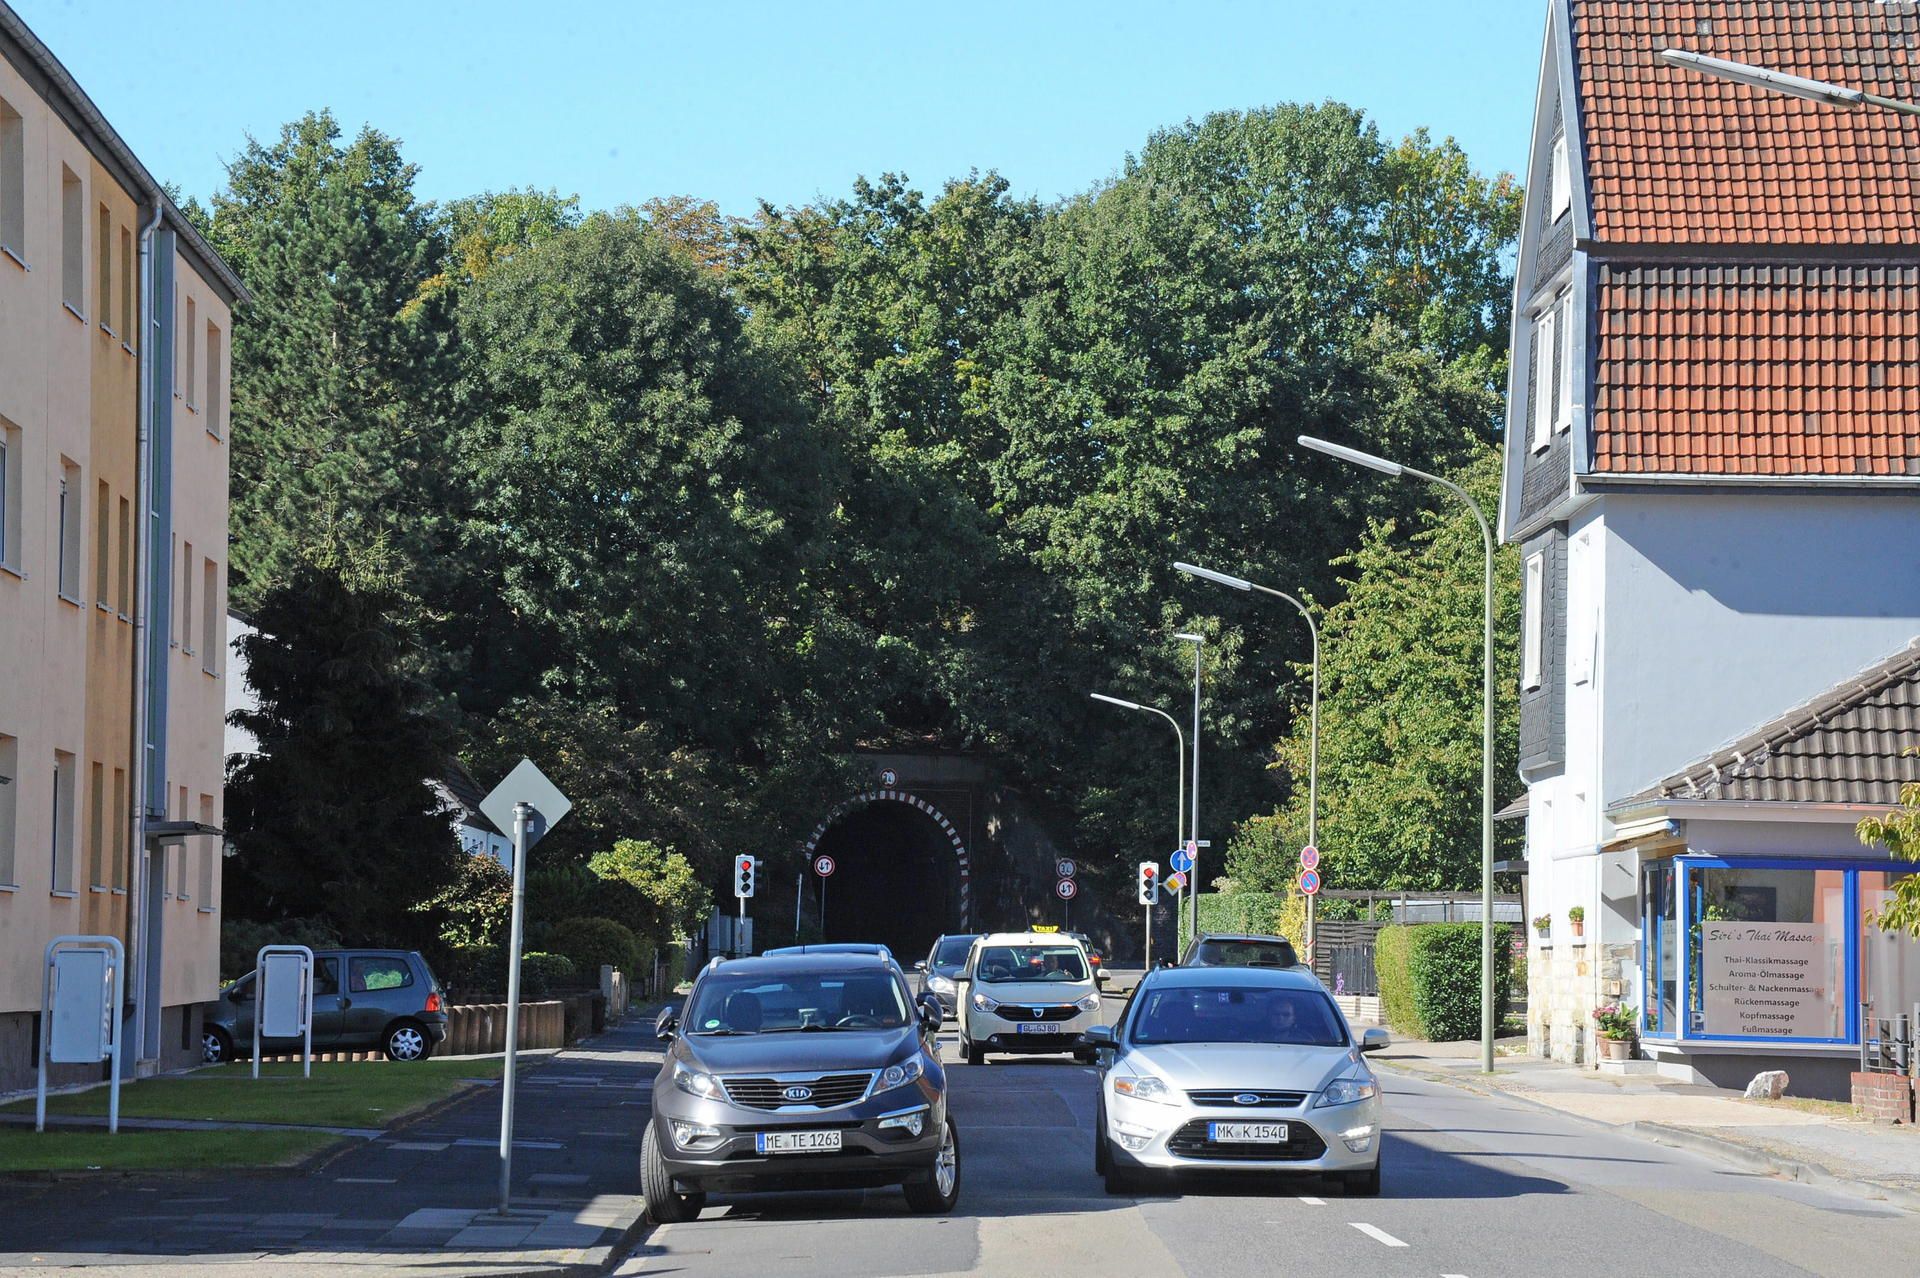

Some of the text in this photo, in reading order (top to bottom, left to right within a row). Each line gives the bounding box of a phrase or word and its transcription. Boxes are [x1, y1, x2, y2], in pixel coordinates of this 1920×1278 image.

[1708, 929, 1742, 941] Siri's
[1746, 929, 1771, 942] Thai
[1724, 956, 1809, 967] Thai-Klassikmassage
[1728, 969, 1805, 980] Aroma-Ölmassage
[1709, 983, 1746, 992] Schulter-
[1748, 984, 1756, 992] &
[1734, 997, 1800, 1008] Rückenmassage
[1739, 1011, 1795, 1022] Kopfmassage
[1742, 1025, 1793, 1036] Fußmassage
[788, 1089, 807, 1099] KIA
[1217, 1125, 1286, 1139] MK K 1540
[766, 1132, 840, 1149] ME TE 1263
